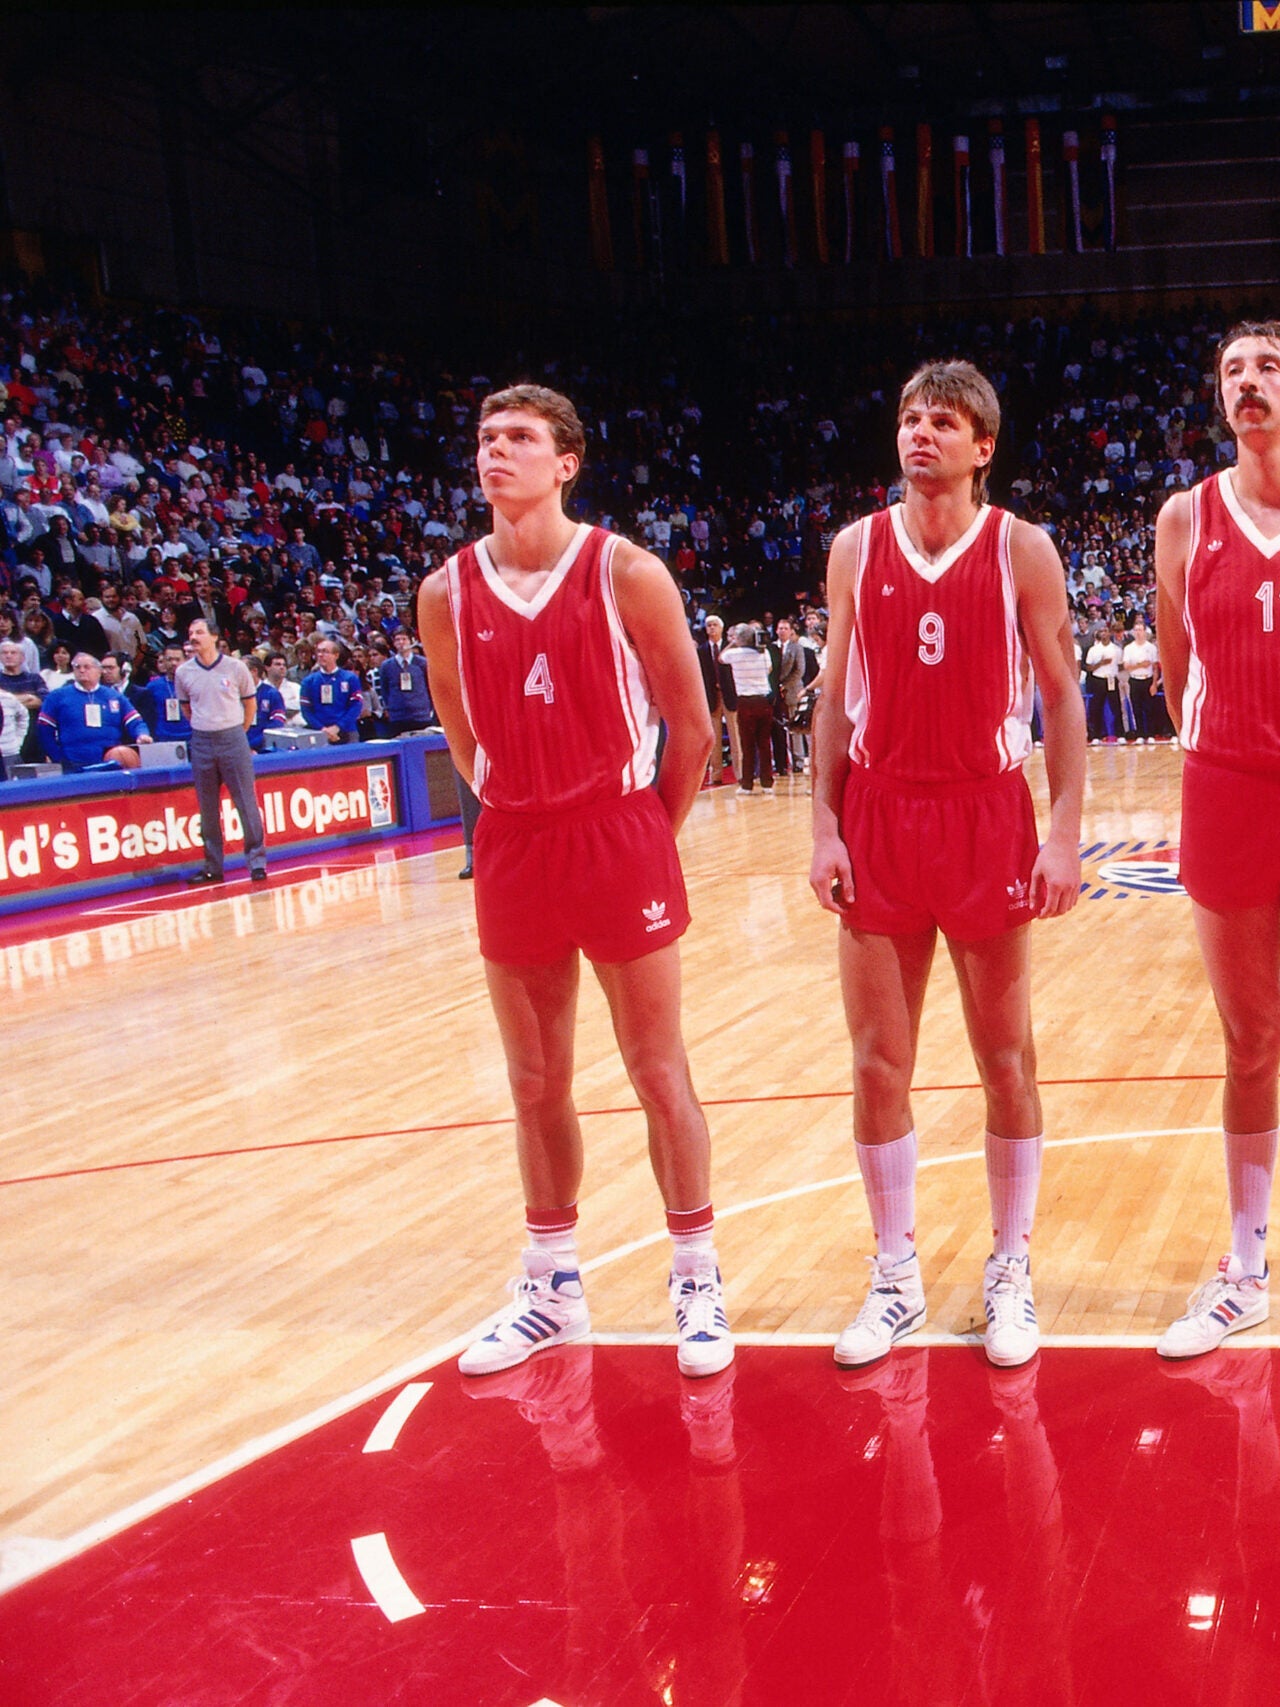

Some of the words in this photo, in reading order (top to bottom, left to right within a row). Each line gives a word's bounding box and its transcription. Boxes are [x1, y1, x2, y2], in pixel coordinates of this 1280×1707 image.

[918, 612, 945, 665] 9
[524, 653, 554, 704] 4
[86, 791, 286, 864] Baskebll
[290, 787, 367, 833] Open
